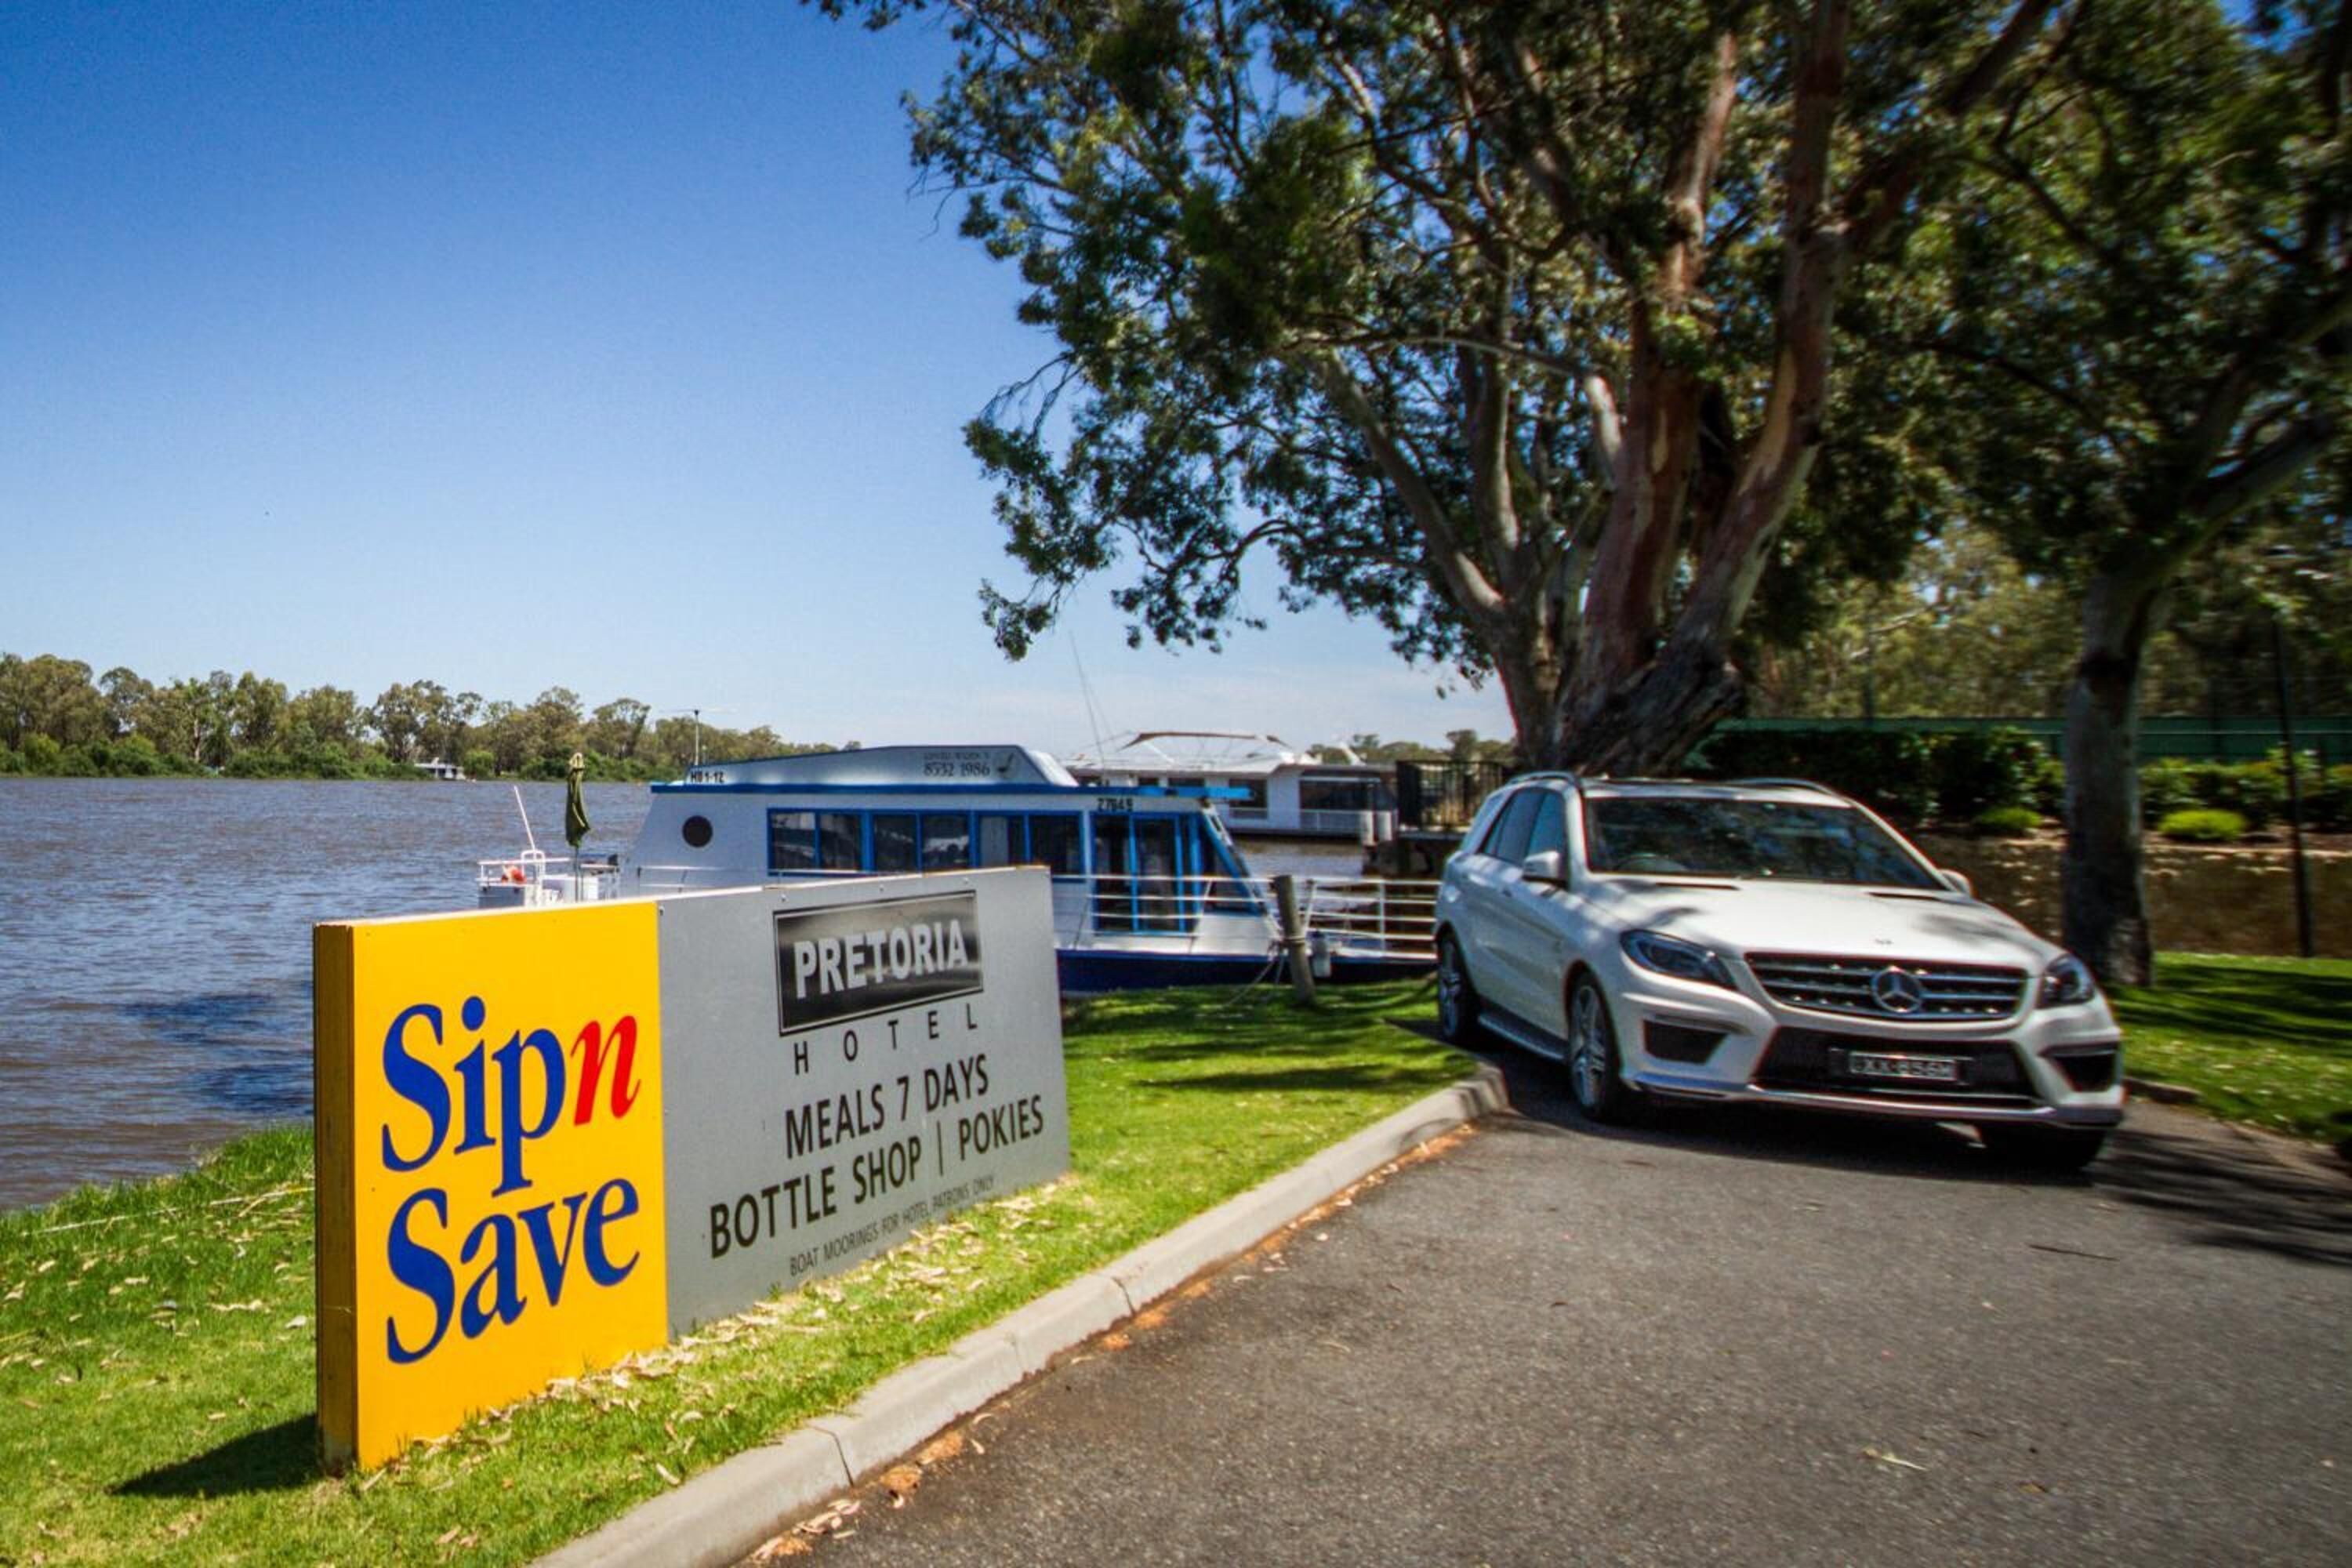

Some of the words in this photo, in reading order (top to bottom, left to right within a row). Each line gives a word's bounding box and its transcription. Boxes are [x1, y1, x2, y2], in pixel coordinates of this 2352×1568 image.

[793, 920, 968, 998] PRETORIA
[793, 1004, 977, 1075] HOTEL
[785, 1083, 884, 1160] MEALS
[898, 1076, 909, 1121] 7
[924, 1054, 989, 1112] DAYS
[710, 1166, 837, 1258] BOTTLE
[852, 1135, 920, 1204] SHOP
[958, 1094, 1044, 1160] POKIES
[386, 1178, 641, 1364] Save
[789, 1247, 819, 1277] BOAT
[824, 1222, 879, 1260] MOORINGS
[882, 1214, 899, 1236] FOR
[902, 1202, 931, 1225] HOTEL
